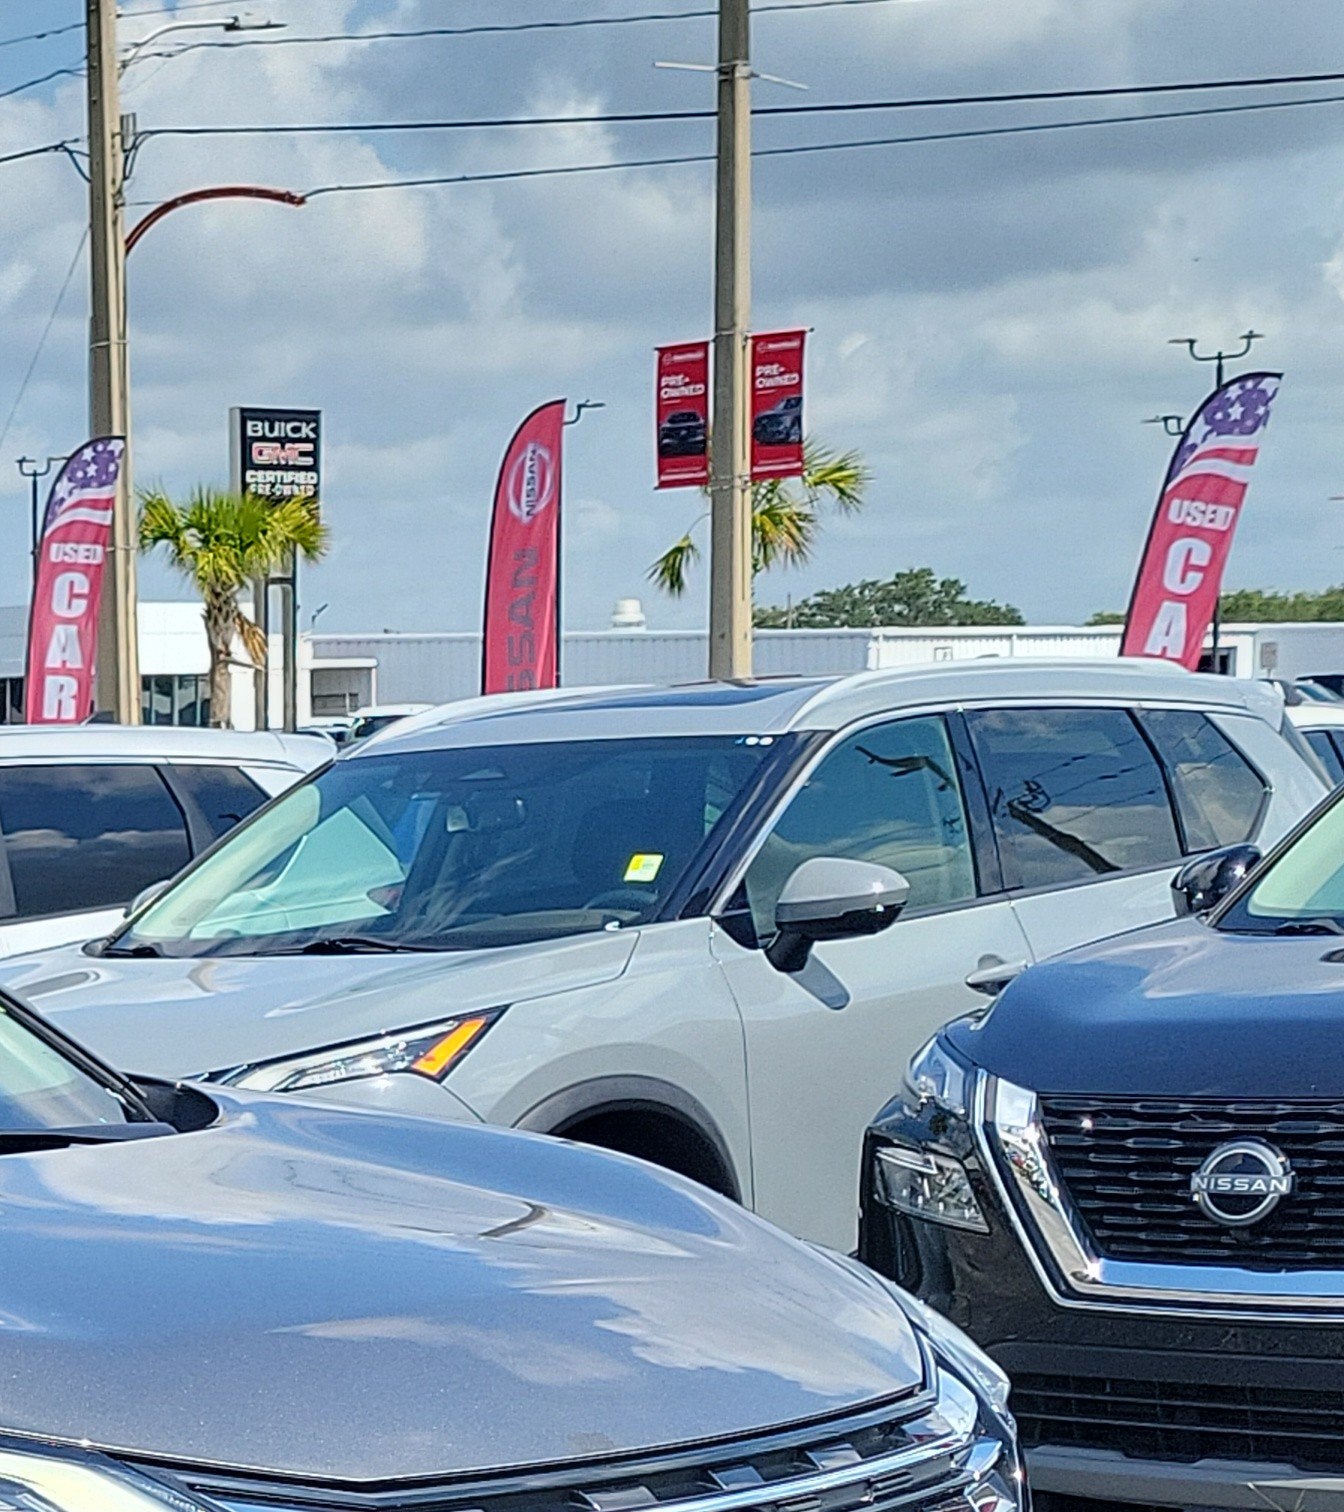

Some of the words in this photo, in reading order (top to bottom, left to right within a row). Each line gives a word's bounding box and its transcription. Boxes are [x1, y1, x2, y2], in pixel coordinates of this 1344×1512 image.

[247, 420, 317, 438] BUICK
[252, 442, 314, 466] GMC
[245, 470, 318, 485] CERTIFIED
[525, 447, 537, 517] NISSAN
[1167, 498, 1236, 531] USED
[49, 542, 104, 566] USED
[1143, 537, 1213, 659] CA
[505, 546, 540, 692] SSAN
[41, 571, 91, 720] CAR
[1194, 1176, 1288, 1192] NISSAN
